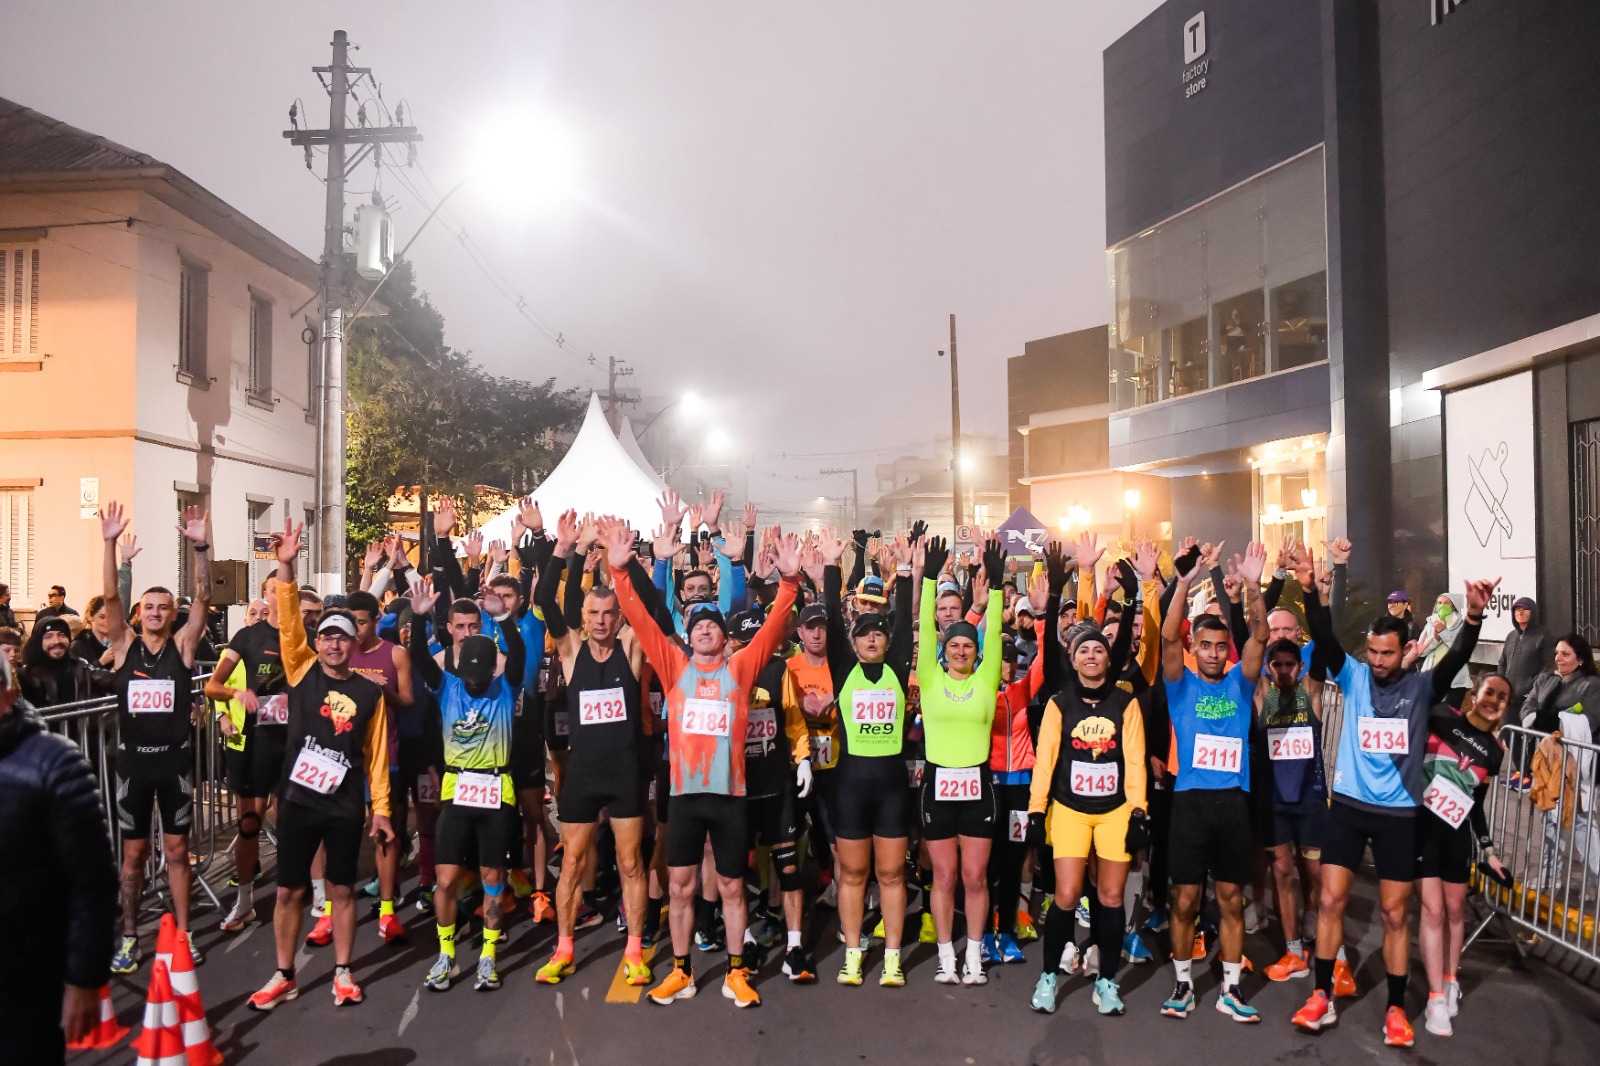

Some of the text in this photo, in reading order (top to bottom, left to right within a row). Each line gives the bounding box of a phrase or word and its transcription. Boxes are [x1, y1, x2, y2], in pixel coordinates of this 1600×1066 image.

[1182, 58, 1209, 84] factory
[1185, 77, 1207, 98] store
[961, 528, 968, 538] E
[1485, 586, 1516, 618] ejar
[132, 691, 173, 709] 2206
[583, 699, 624, 721] 2132
[856, 701, 895, 719] 2187
[260, 705, 288, 722] 216
[685, 710, 728, 732] 2184
[746, 719, 776, 739] 226
[859, 723, 894, 735] Re9
[136, 744, 170, 753] TECHFIT
[1272, 738, 1312, 757] 2169
[1361, 729, 1406, 750] 2134
[1196, 746, 1238, 768] 2111
[295, 761, 339, 793] 2211
[1074, 773, 1116, 793] 2143
[458, 783, 499, 804] 2215
[939, 779, 980, 797] 2216
[1423, 787, 1466, 824] 2123
